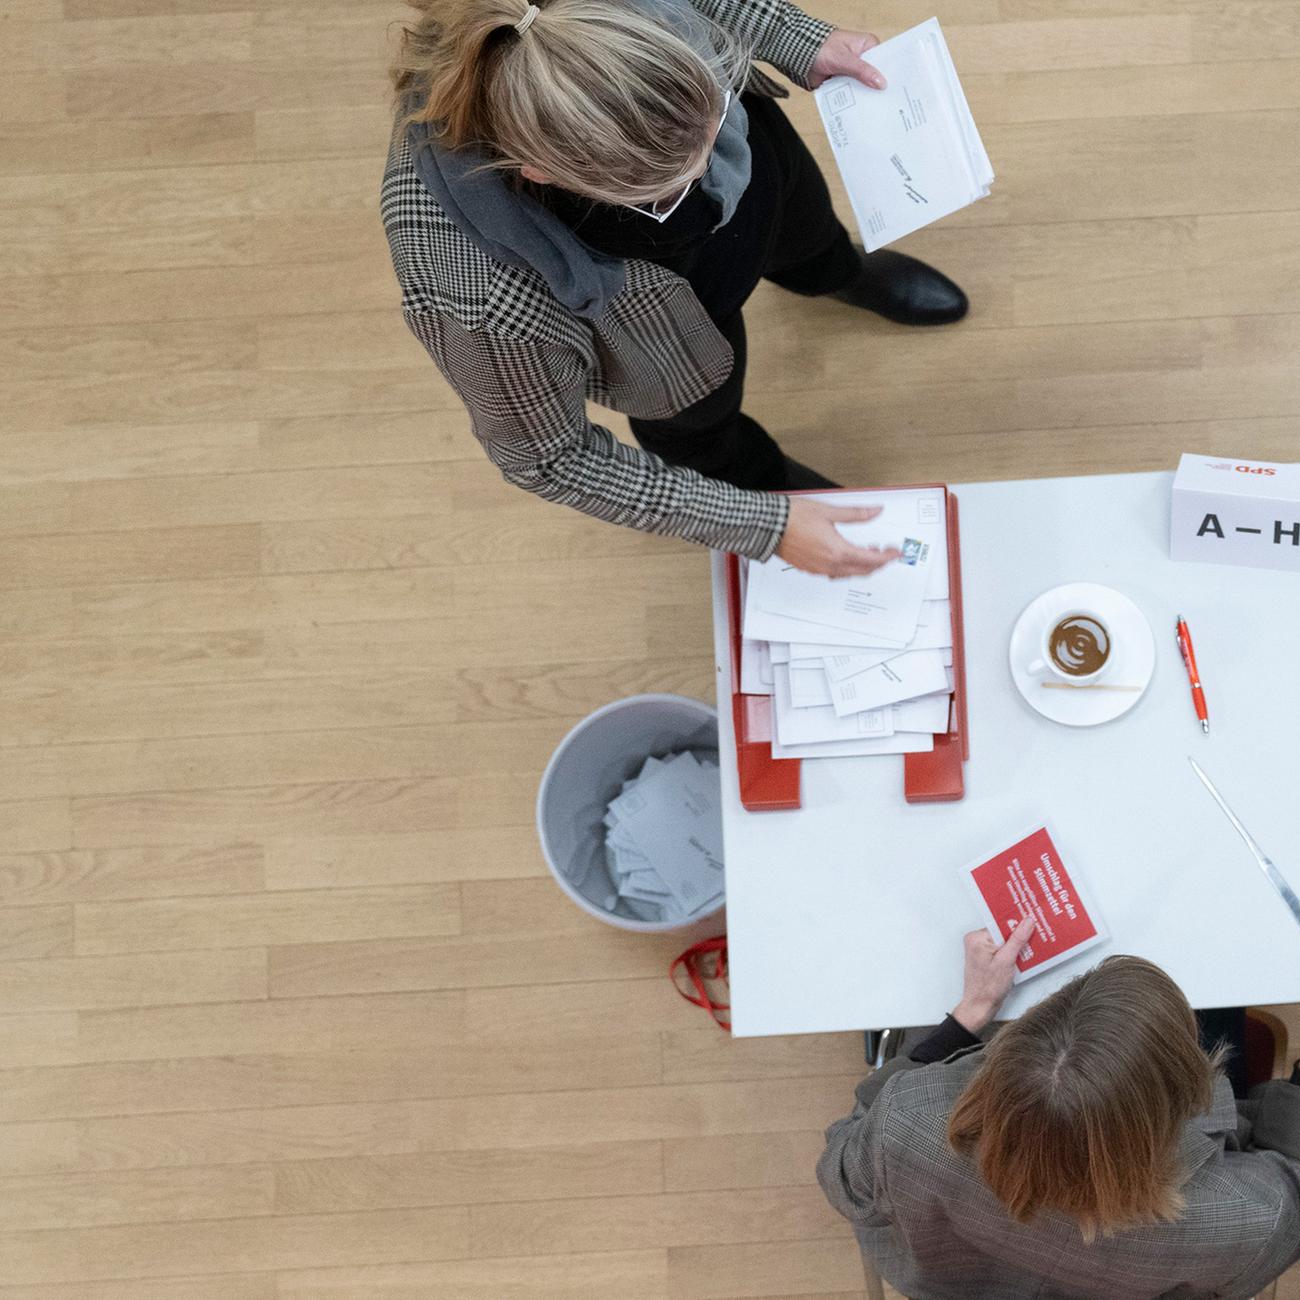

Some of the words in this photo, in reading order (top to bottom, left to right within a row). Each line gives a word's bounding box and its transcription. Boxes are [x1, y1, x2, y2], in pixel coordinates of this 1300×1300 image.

[1235, 465, 1277, 477] SPD
[1196, 514, 1225, 538] A
[1273, 520, 1300, 546] H
[1032, 866, 1063, 917] Stimmzettel
[1038, 852, 1064, 892] Umschlag
[1057, 889, 1071, 904] für
[1064, 902, 1079, 920] den
